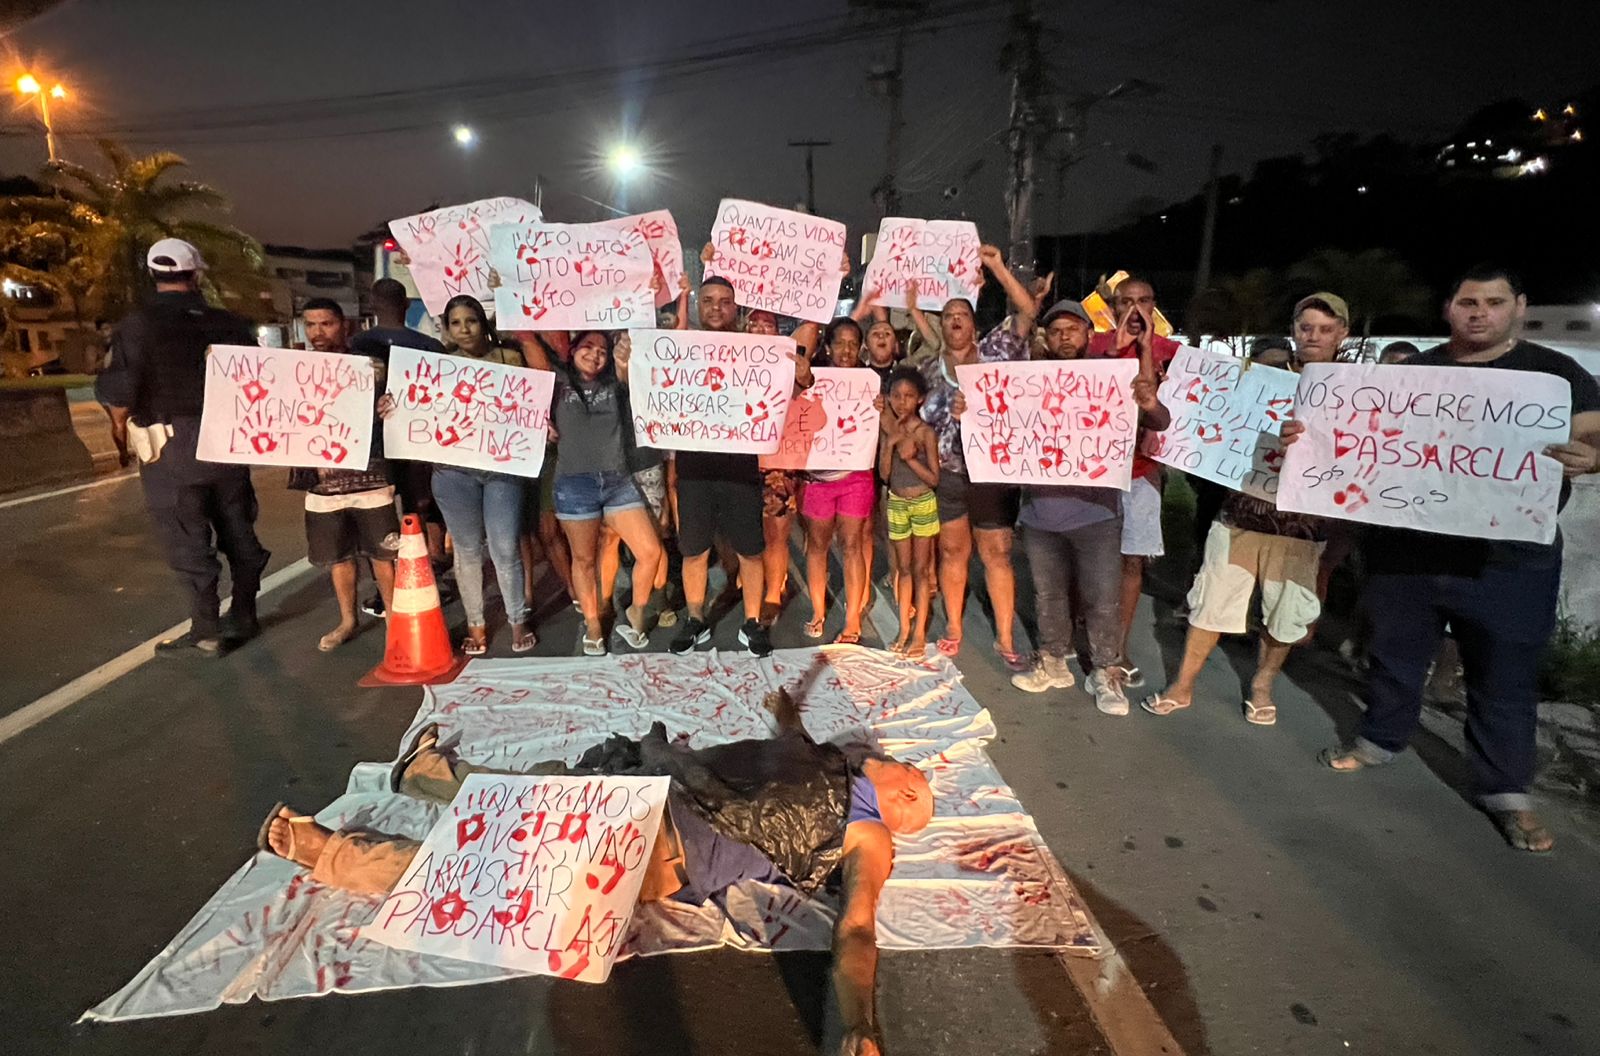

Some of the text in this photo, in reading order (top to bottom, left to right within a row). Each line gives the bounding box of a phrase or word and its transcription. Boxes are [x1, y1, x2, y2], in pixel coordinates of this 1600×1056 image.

[722, 204, 845, 248] QUANTAS VIDAS
[512, 230, 572, 252] LUTO
[577, 239, 625, 256] LUTO
[516, 255, 570, 284] LUTO
[579, 265, 627, 288] LUTO
[710, 250, 823, 292] PERDER PARA A
[800, 247, 827, 273] SE
[806, 292, 827, 309] DO
[879, 277, 950, 298] IMPRTAM
[521, 288, 633, 324] LUTO LUTO
[654, 336, 780, 365] QUEREMOS
[211, 354, 277, 384] MAIS
[732, 365, 772, 388] NÃO
[1185, 356, 1241, 383] LUTO
[235, 394, 340, 427] MENOS
[1295, 373, 1569, 430] NÓS QUEREMOS
[691, 419, 778, 442] PASSARELA
[976, 408, 1046, 431] SALVA
[1173, 416, 1223, 444] UTO
[408, 418, 527, 461] BUZINE
[966, 432, 986, 456] A
[999, 456, 1082, 478] CARO!
[1159, 445, 1279, 495] UTO LUTO
[1334, 432, 1539, 482] PASSARELA
[480, 780, 652, 822] QUEREMOS
[575, 822, 647, 871] NÃO
[404, 851, 571, 911] ARRISCAR
[383, 890, 594, 957] PASSARELA
